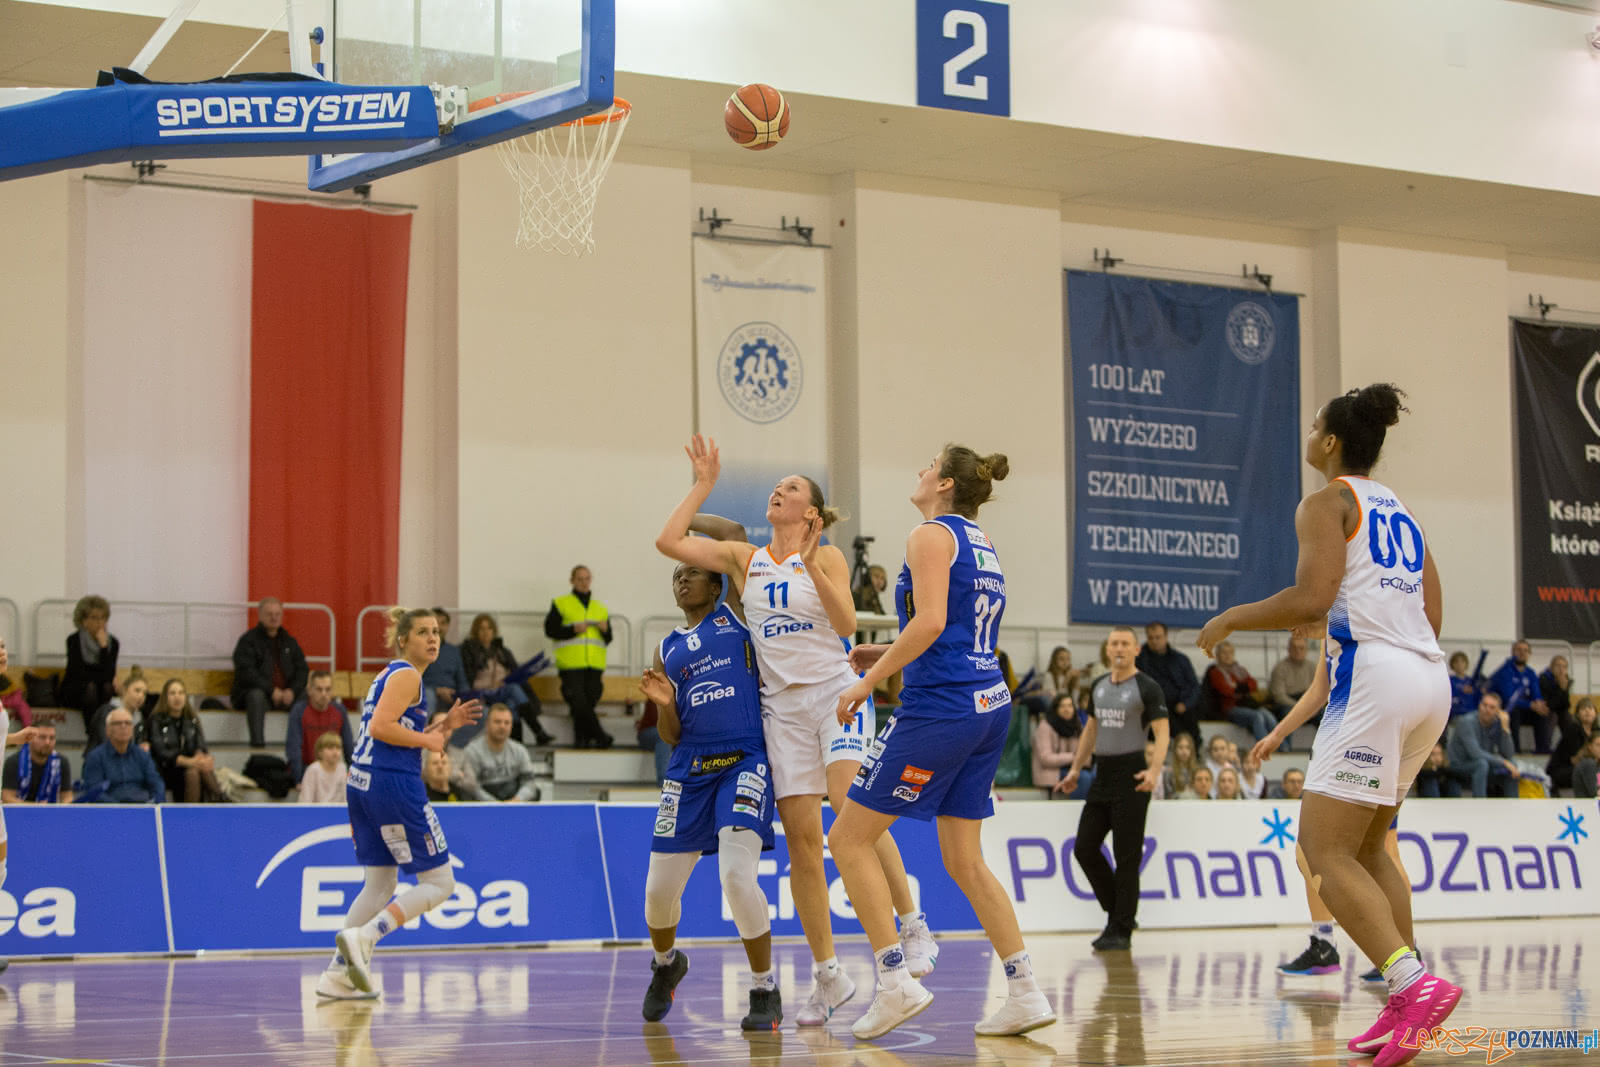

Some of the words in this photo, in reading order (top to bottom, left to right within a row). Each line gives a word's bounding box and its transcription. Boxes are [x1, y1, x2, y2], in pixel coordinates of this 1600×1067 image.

[943, 10, 988, 100] 2
[1088, 364, 1124, 391] 100
[1128, 369, 1165, 395] LAT
[1088, 414, 1197, 451] WYŻSZEGO
[1088, 471, 1230, 506] SZKOLNICTWA
[1088, 525, 1240, 560] TECHNICZNEGO
[1369, 508, 1423, 573] 00
[764, 581, 788, 608] 11
[1089, 579, 1110, 606] W
[1117, 580, 1219, 611] POZNANIU
[686, 633, 702, 651] 8
[764, 623, 813, 637] Enea
[691, 686, 735, 706] Enea
[1344, 750, 1383, 765] AGROBEX
[1336, 771, 1368, 783] green
[300, 866, 529, 932] Eea
